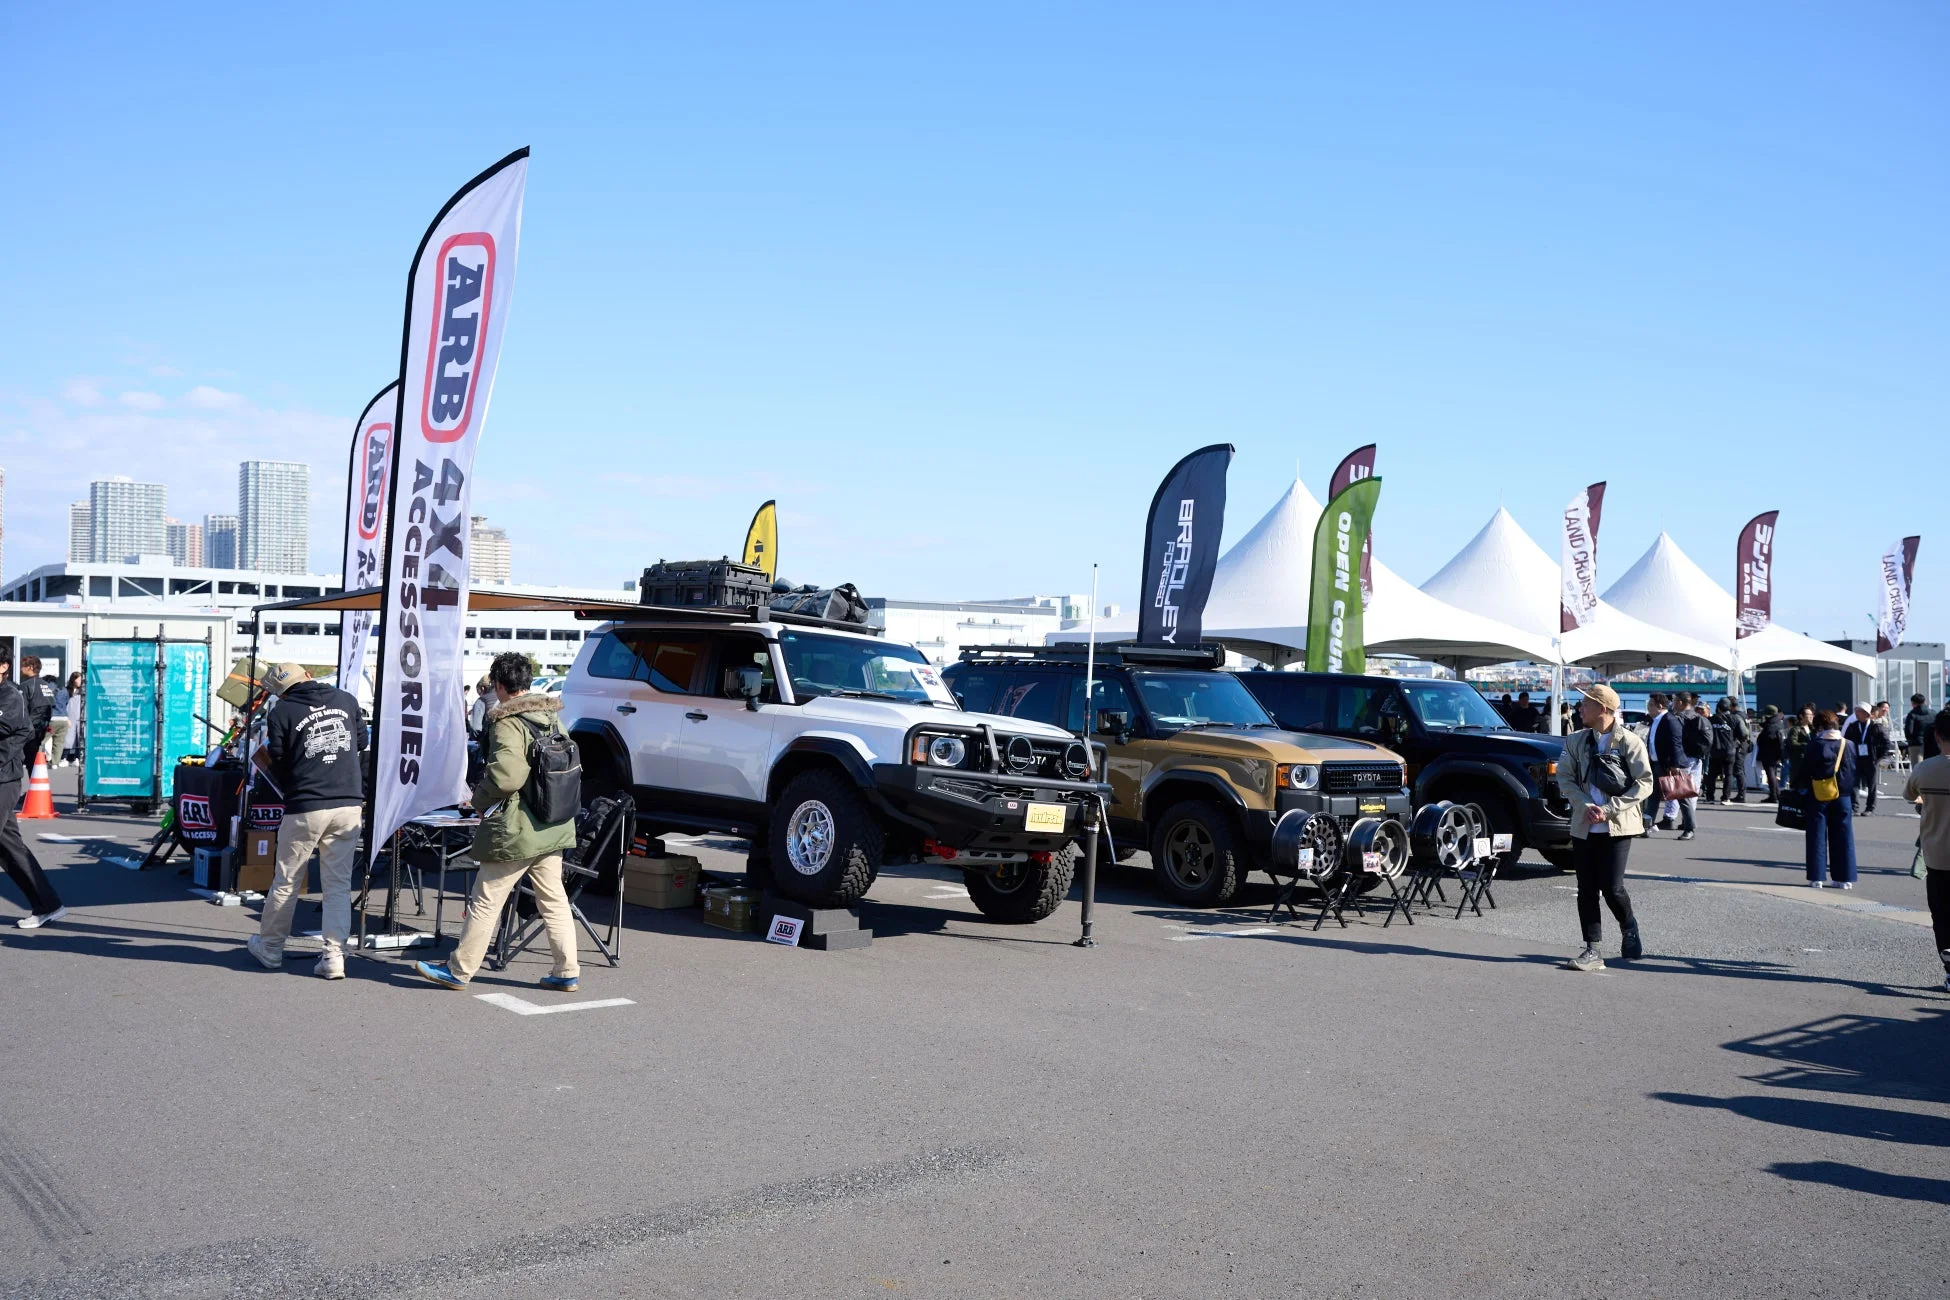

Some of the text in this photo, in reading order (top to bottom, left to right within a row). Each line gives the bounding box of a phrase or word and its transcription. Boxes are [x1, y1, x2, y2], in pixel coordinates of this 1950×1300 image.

[432, 256, 485, 424] ARB
[362, 435, 388, 529] ARB
[420, 458, 465, 613] 4X4
[1162, 498, 1195, 644] BRADLEY
[1334, 511, 1352, 593] OPEN
[1564, 507, 1598, 612] LAND CRUISER
[1751, 523, 1773, 596] ランクル
[1882, 554, 1898, 587] LAND
[1154, 541, 1176, 608] FORGED
[1743, 563, 1751, 604] BASE
[399, 458, 434, 786] ACCESSORIES
[184, 651, 195, 692] Zone
[1352, 773, 1381, 782] TOYOTA
[776, 923, 795, 936] ARB
